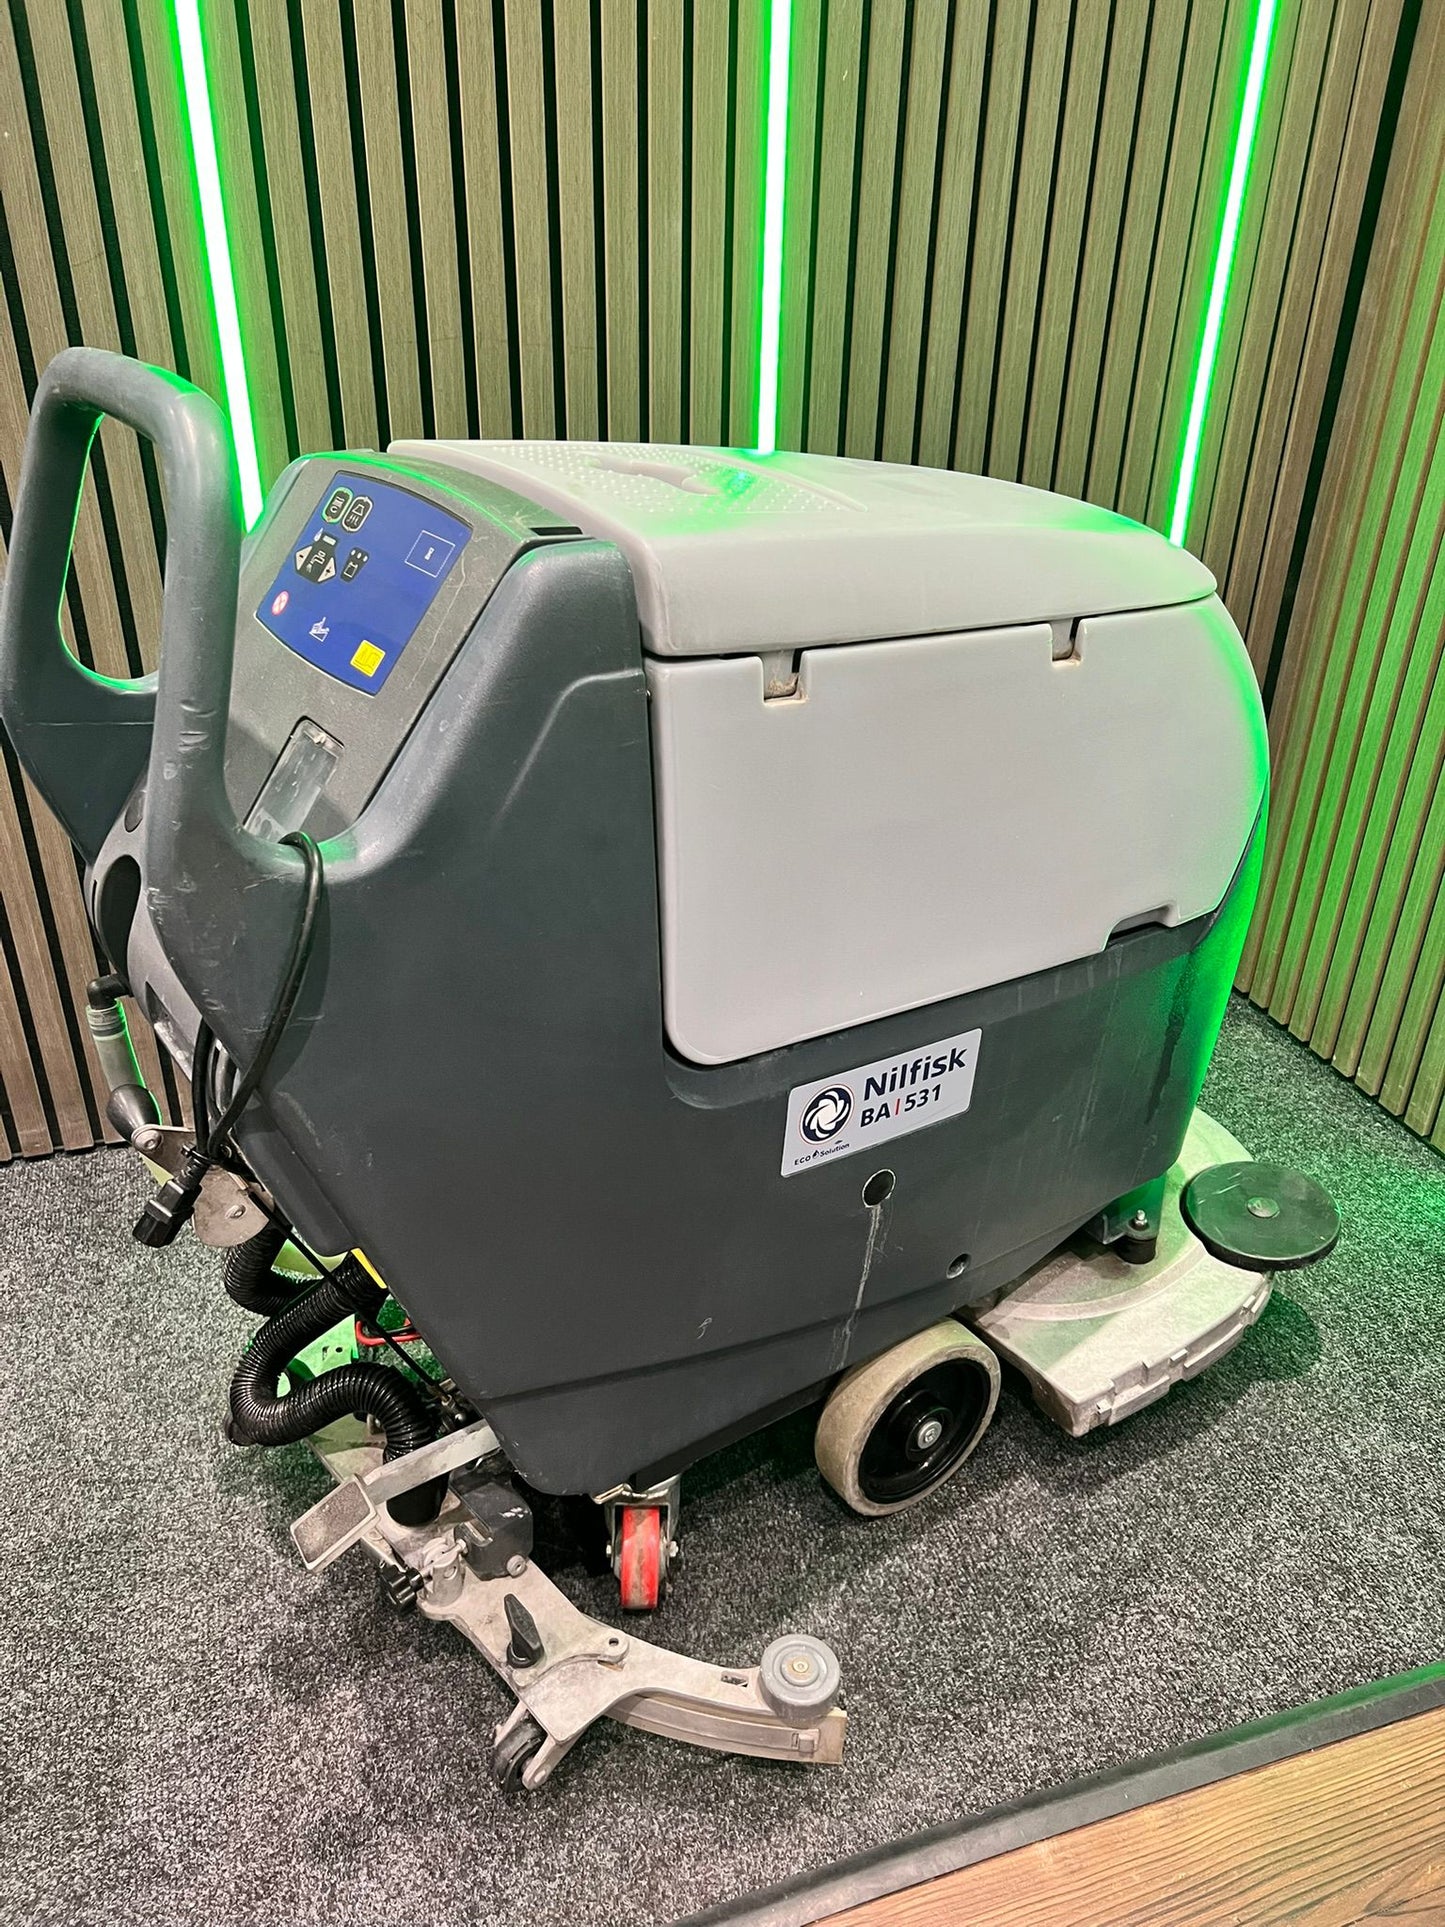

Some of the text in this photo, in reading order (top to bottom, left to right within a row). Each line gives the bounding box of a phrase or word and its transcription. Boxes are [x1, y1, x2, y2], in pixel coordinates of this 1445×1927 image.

[864, 1047, 967, 1101] Nilfisk
[794, 1144, 850, 1166] ECO Solution
